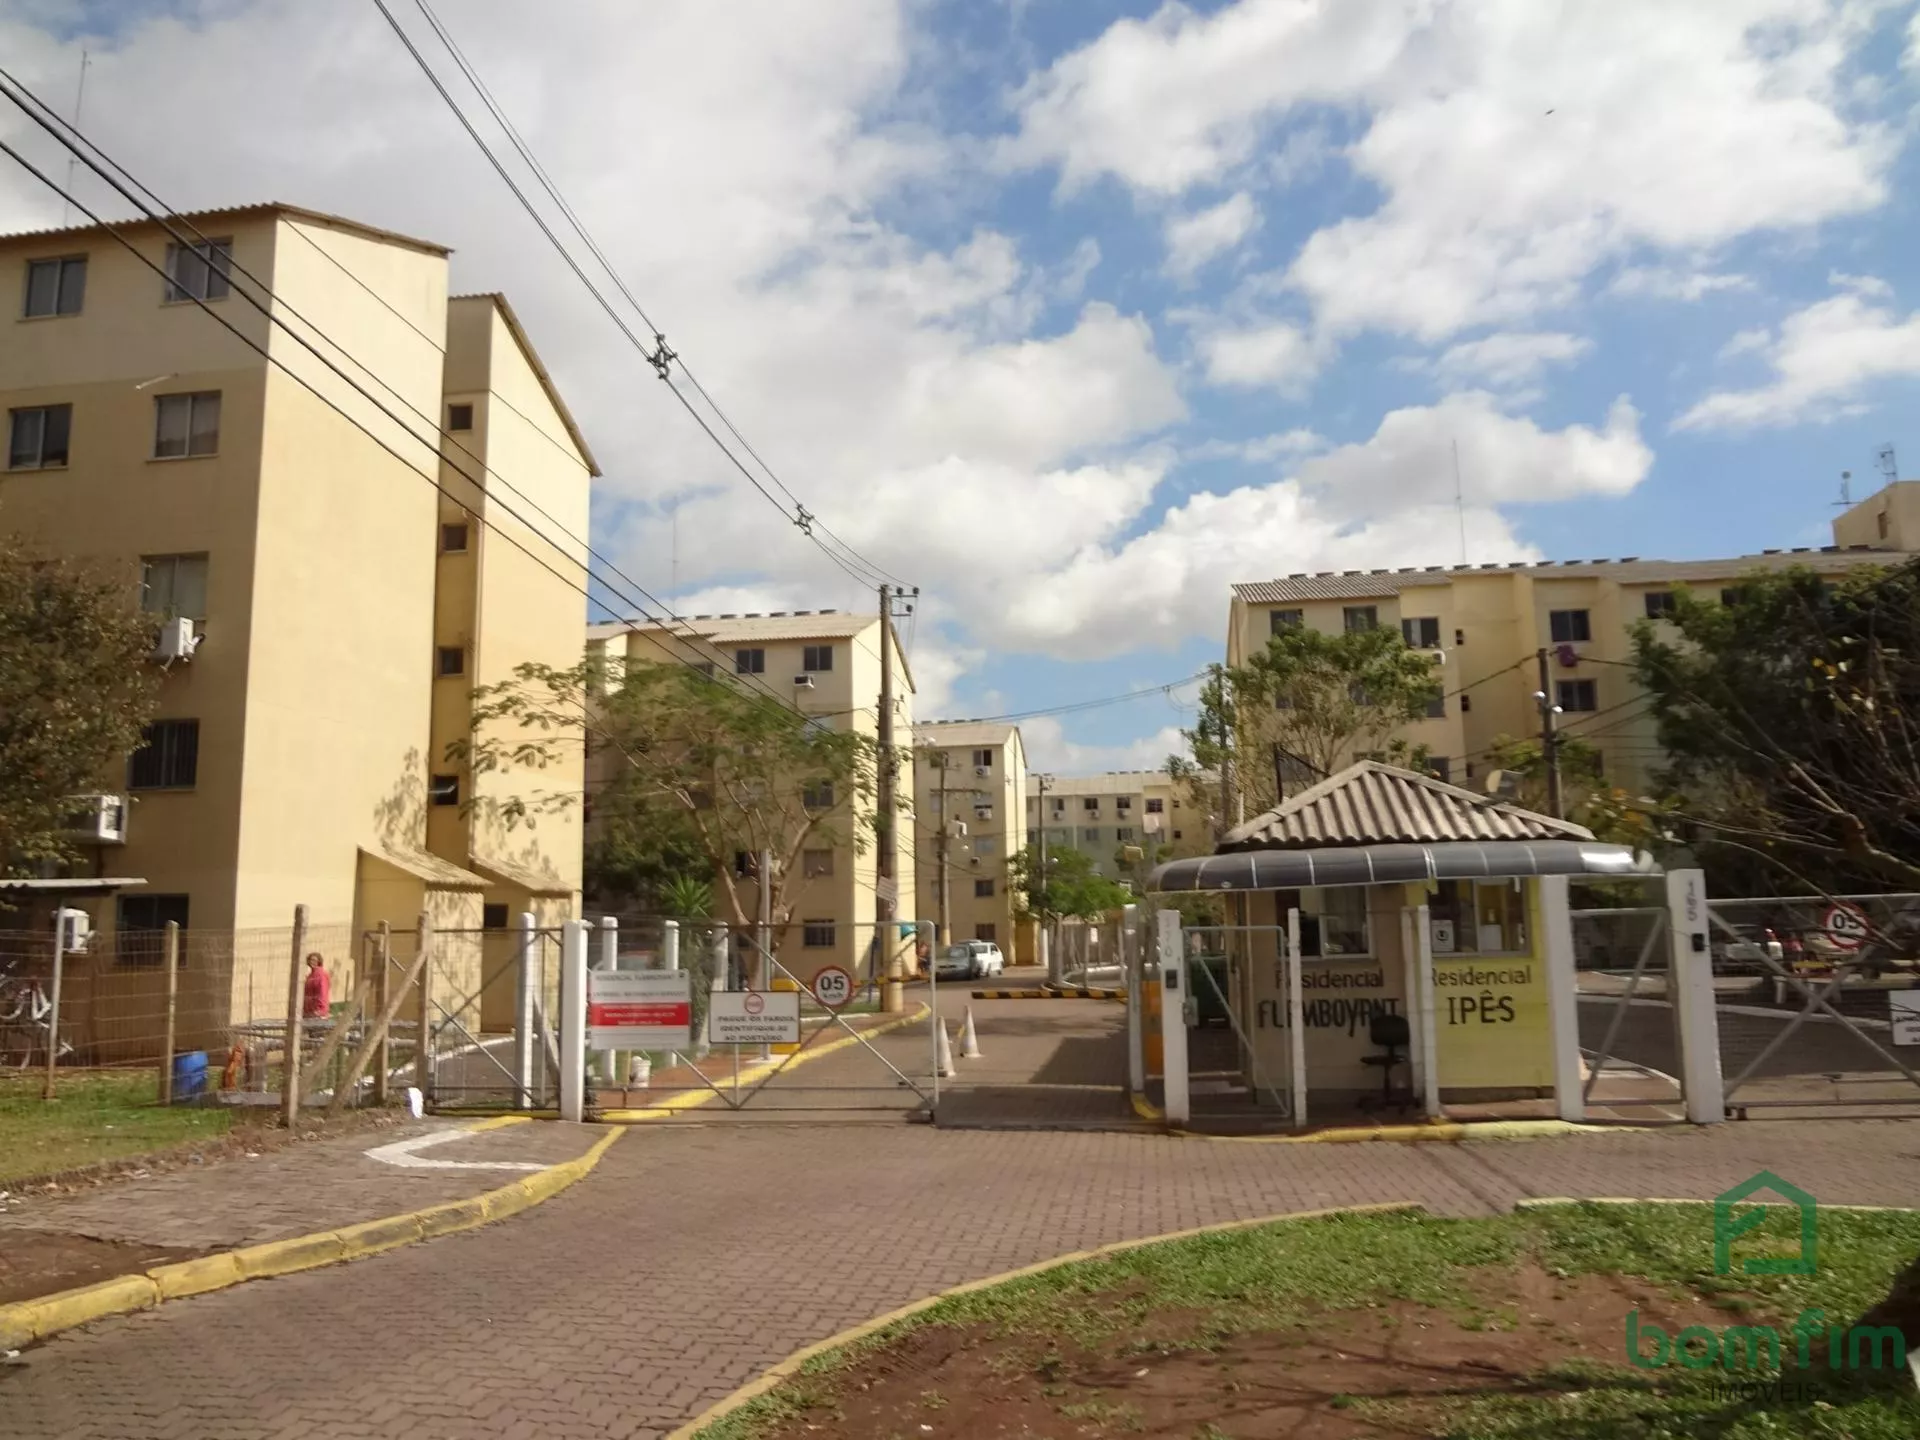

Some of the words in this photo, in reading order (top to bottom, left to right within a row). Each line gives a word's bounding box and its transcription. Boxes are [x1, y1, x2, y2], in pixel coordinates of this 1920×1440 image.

[820, 975, 845, 991] 05
[1275, 967, 1385, 990] Rsidencial
[1446, 989, 1516, 1026] IPÊS
